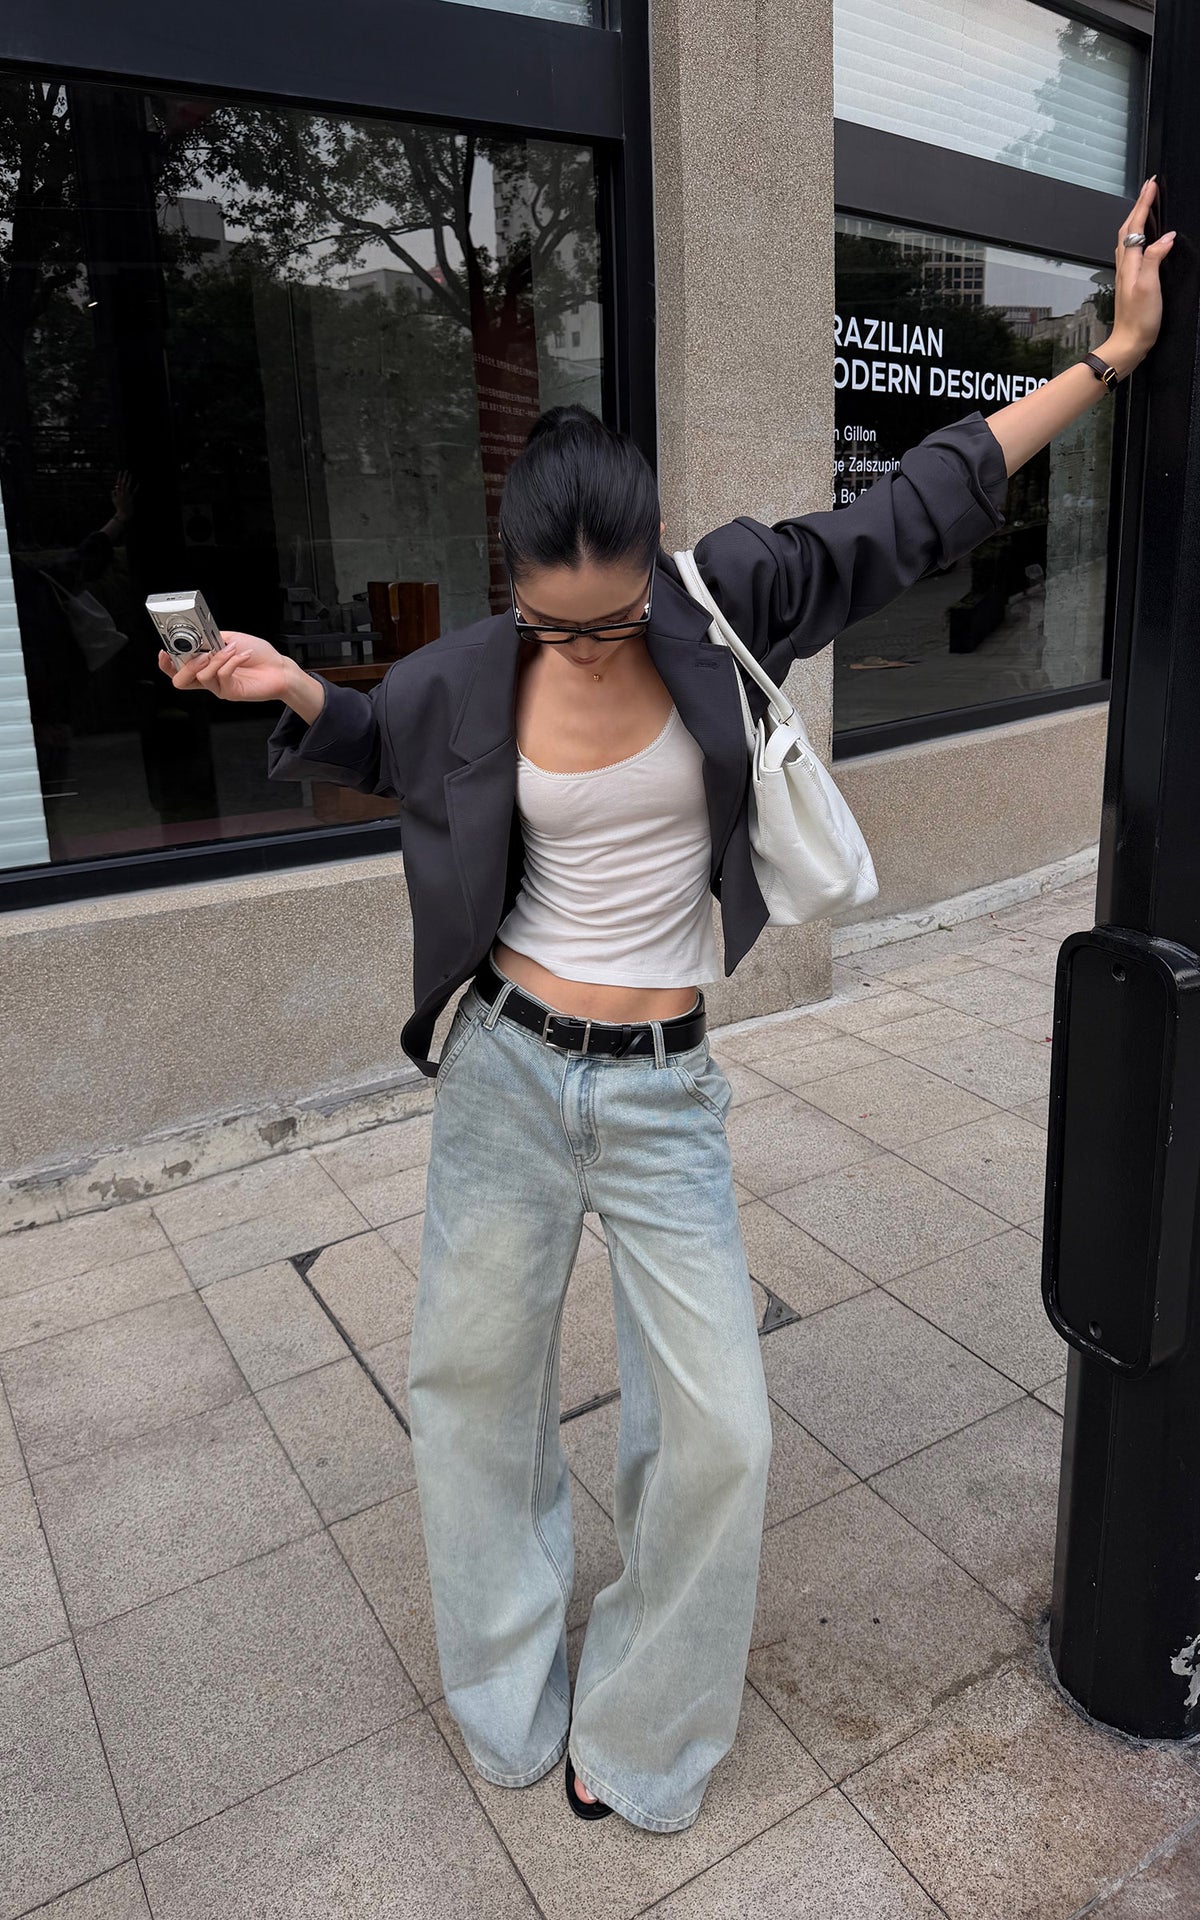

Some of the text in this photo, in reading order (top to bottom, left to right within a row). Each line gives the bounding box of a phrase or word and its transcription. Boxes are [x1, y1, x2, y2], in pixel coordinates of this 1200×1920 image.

[834, 356, 921, 395] ODERN
[843, 425, 877, 442] Gillon
[840, 488, 857, 504] Bo
